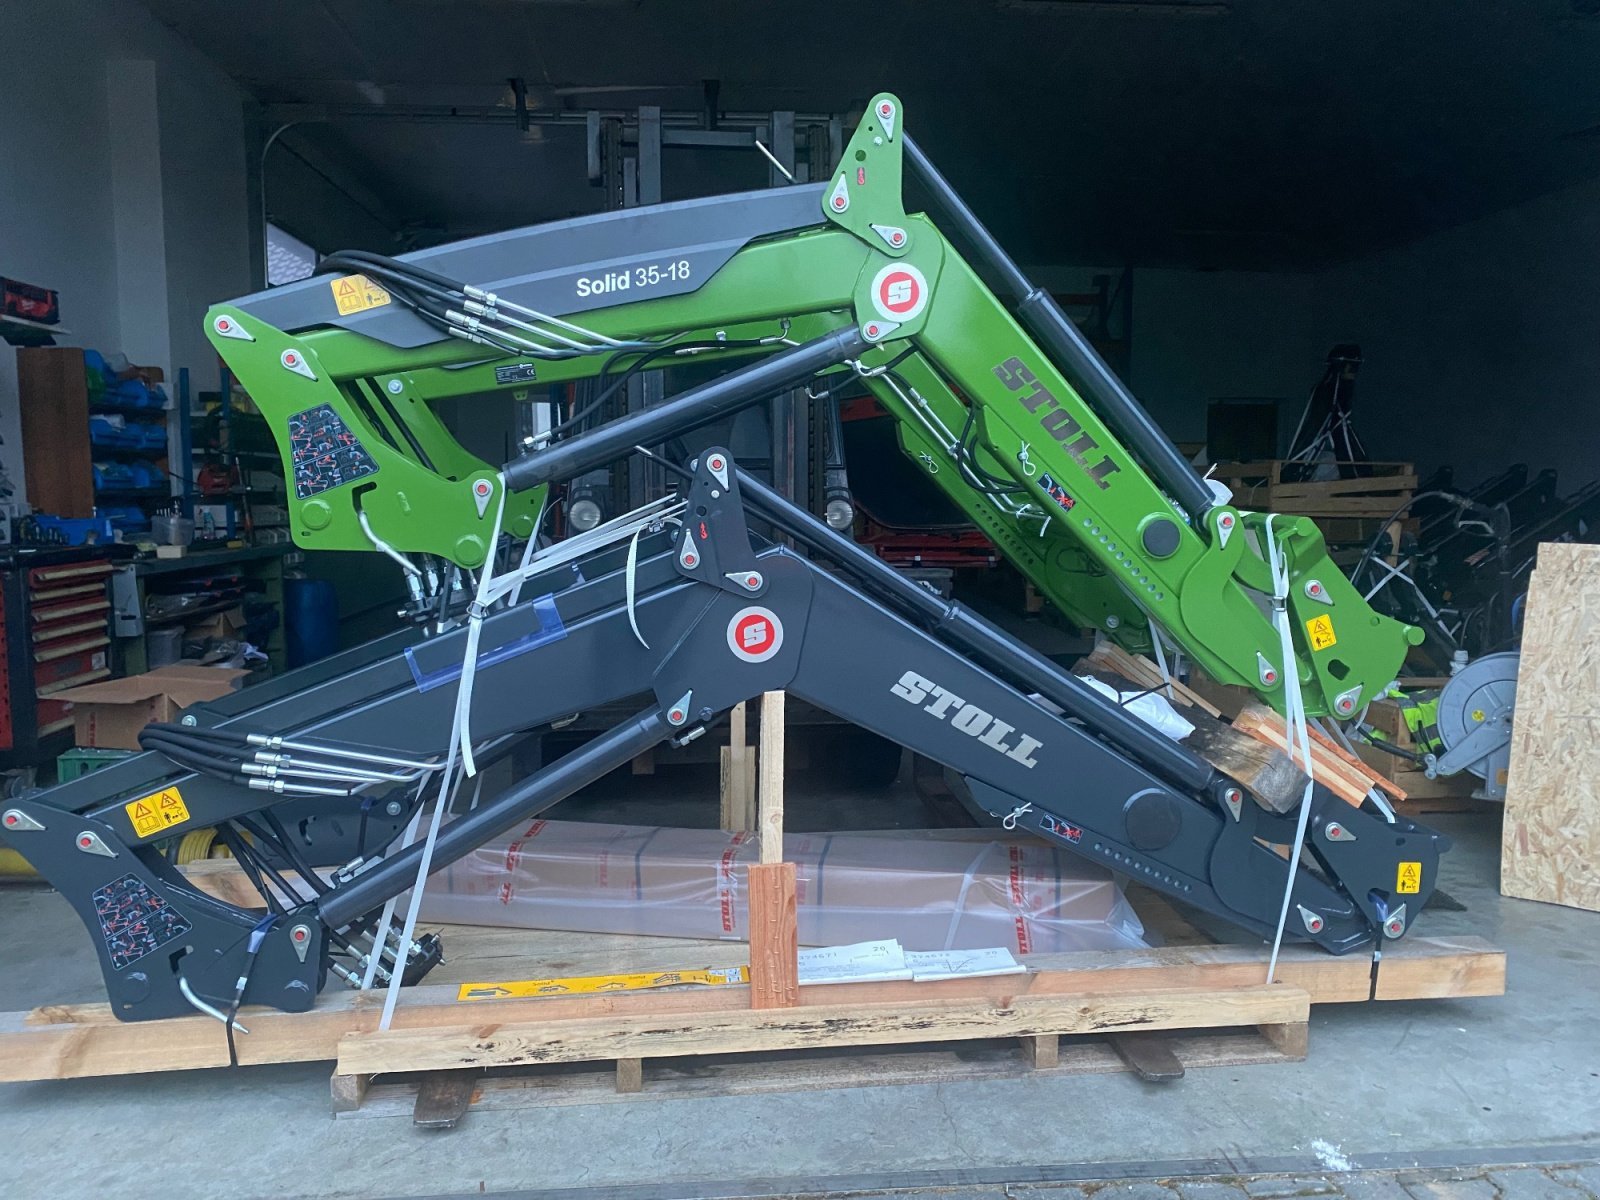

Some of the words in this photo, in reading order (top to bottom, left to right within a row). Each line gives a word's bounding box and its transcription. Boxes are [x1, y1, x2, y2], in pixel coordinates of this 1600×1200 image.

[576, 271, 630, 297] Solid
[635, 260, 690, 287] 35-18
[887, 279, 912, 306] S
[991, 355, 1121, 491] STOLL
[743, 620, 767, 648] S
[889, 670, 1044, 769] STOLL
